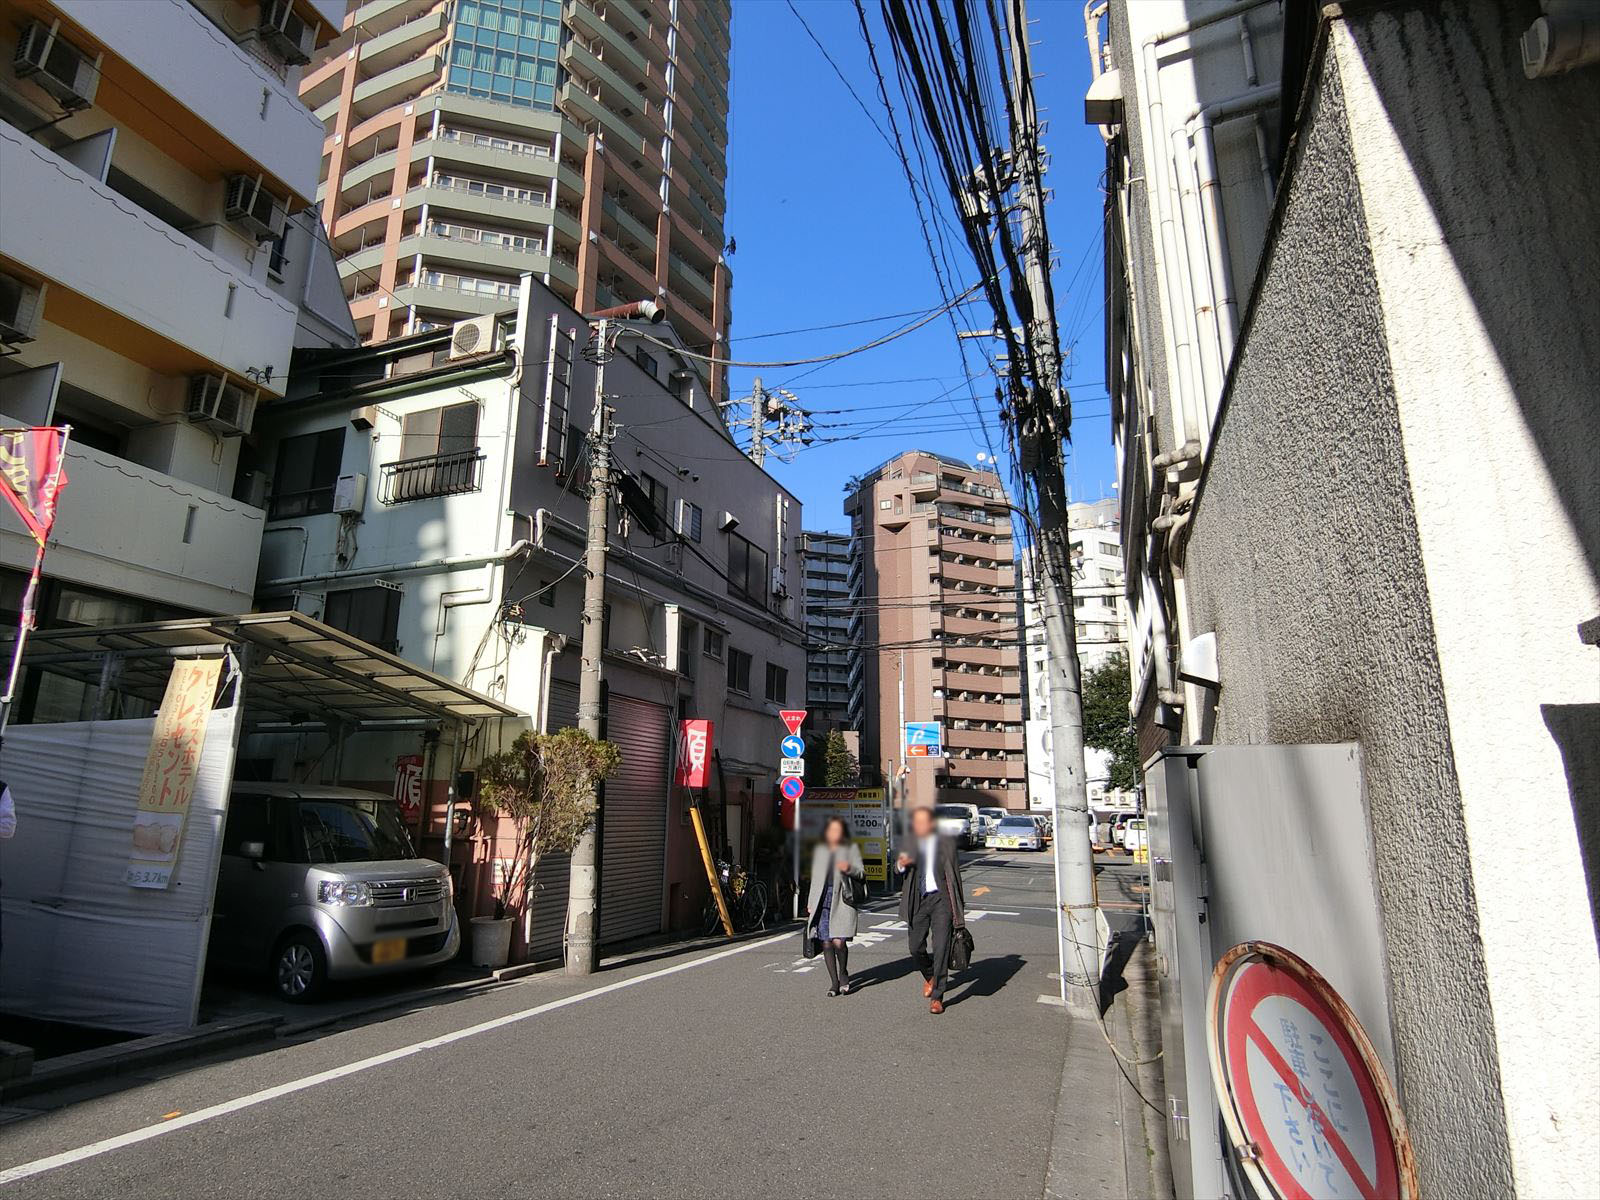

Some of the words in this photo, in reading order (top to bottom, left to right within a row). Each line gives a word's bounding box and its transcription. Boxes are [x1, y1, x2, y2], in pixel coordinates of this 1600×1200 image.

[159, 668, 203, 805] クレセント
[174, 670, 217, 805] ビジネスホテル
